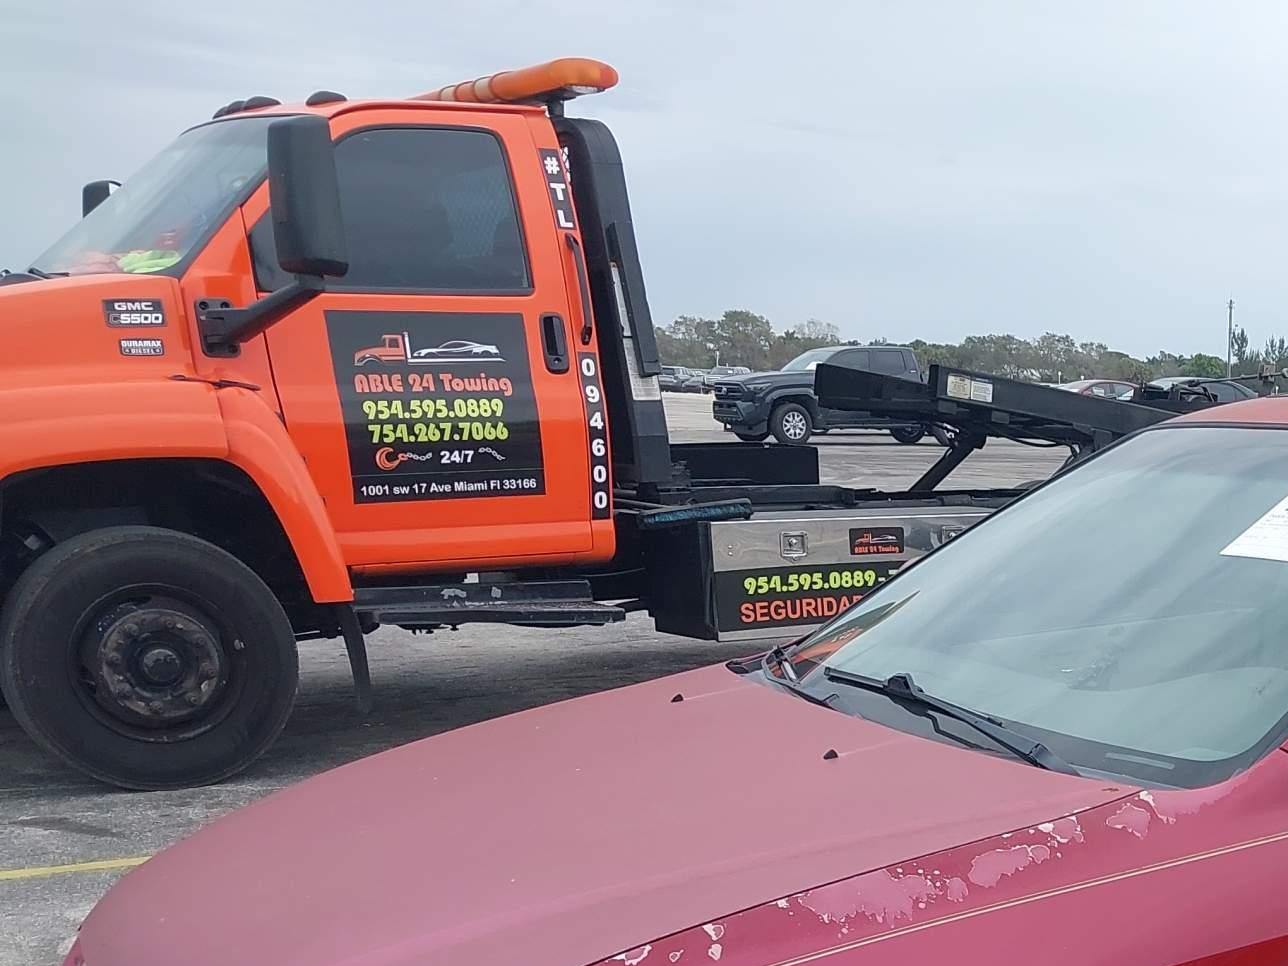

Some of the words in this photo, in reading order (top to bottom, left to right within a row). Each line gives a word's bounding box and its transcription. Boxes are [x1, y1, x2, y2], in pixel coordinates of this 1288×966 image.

[113, 301, 154, 311] GMC
[109, 313, 163, 324] C5500
[354, 373, 404, 393] ABLE
[408, 373, 435, 392] 24
[439, 372, 513, 396] Towing
[362, 398, 504, 420] 954.595.0889
[367, 421, 509, 443] 754.267.7066
[581, 358, 608, 509] 094600
[440, 450, 475, 464] 24/7
[360, 484, 389, 496] 1001
[393, 486, 410, 495] sw
[412, 483, 427, 494] 17
[430, 482, 451, 493] Ave
[454, 480, 488, 492] Miami
[502, 478, 537, 490] 33166
[743, 570, 876, 595] 954.595.0889
